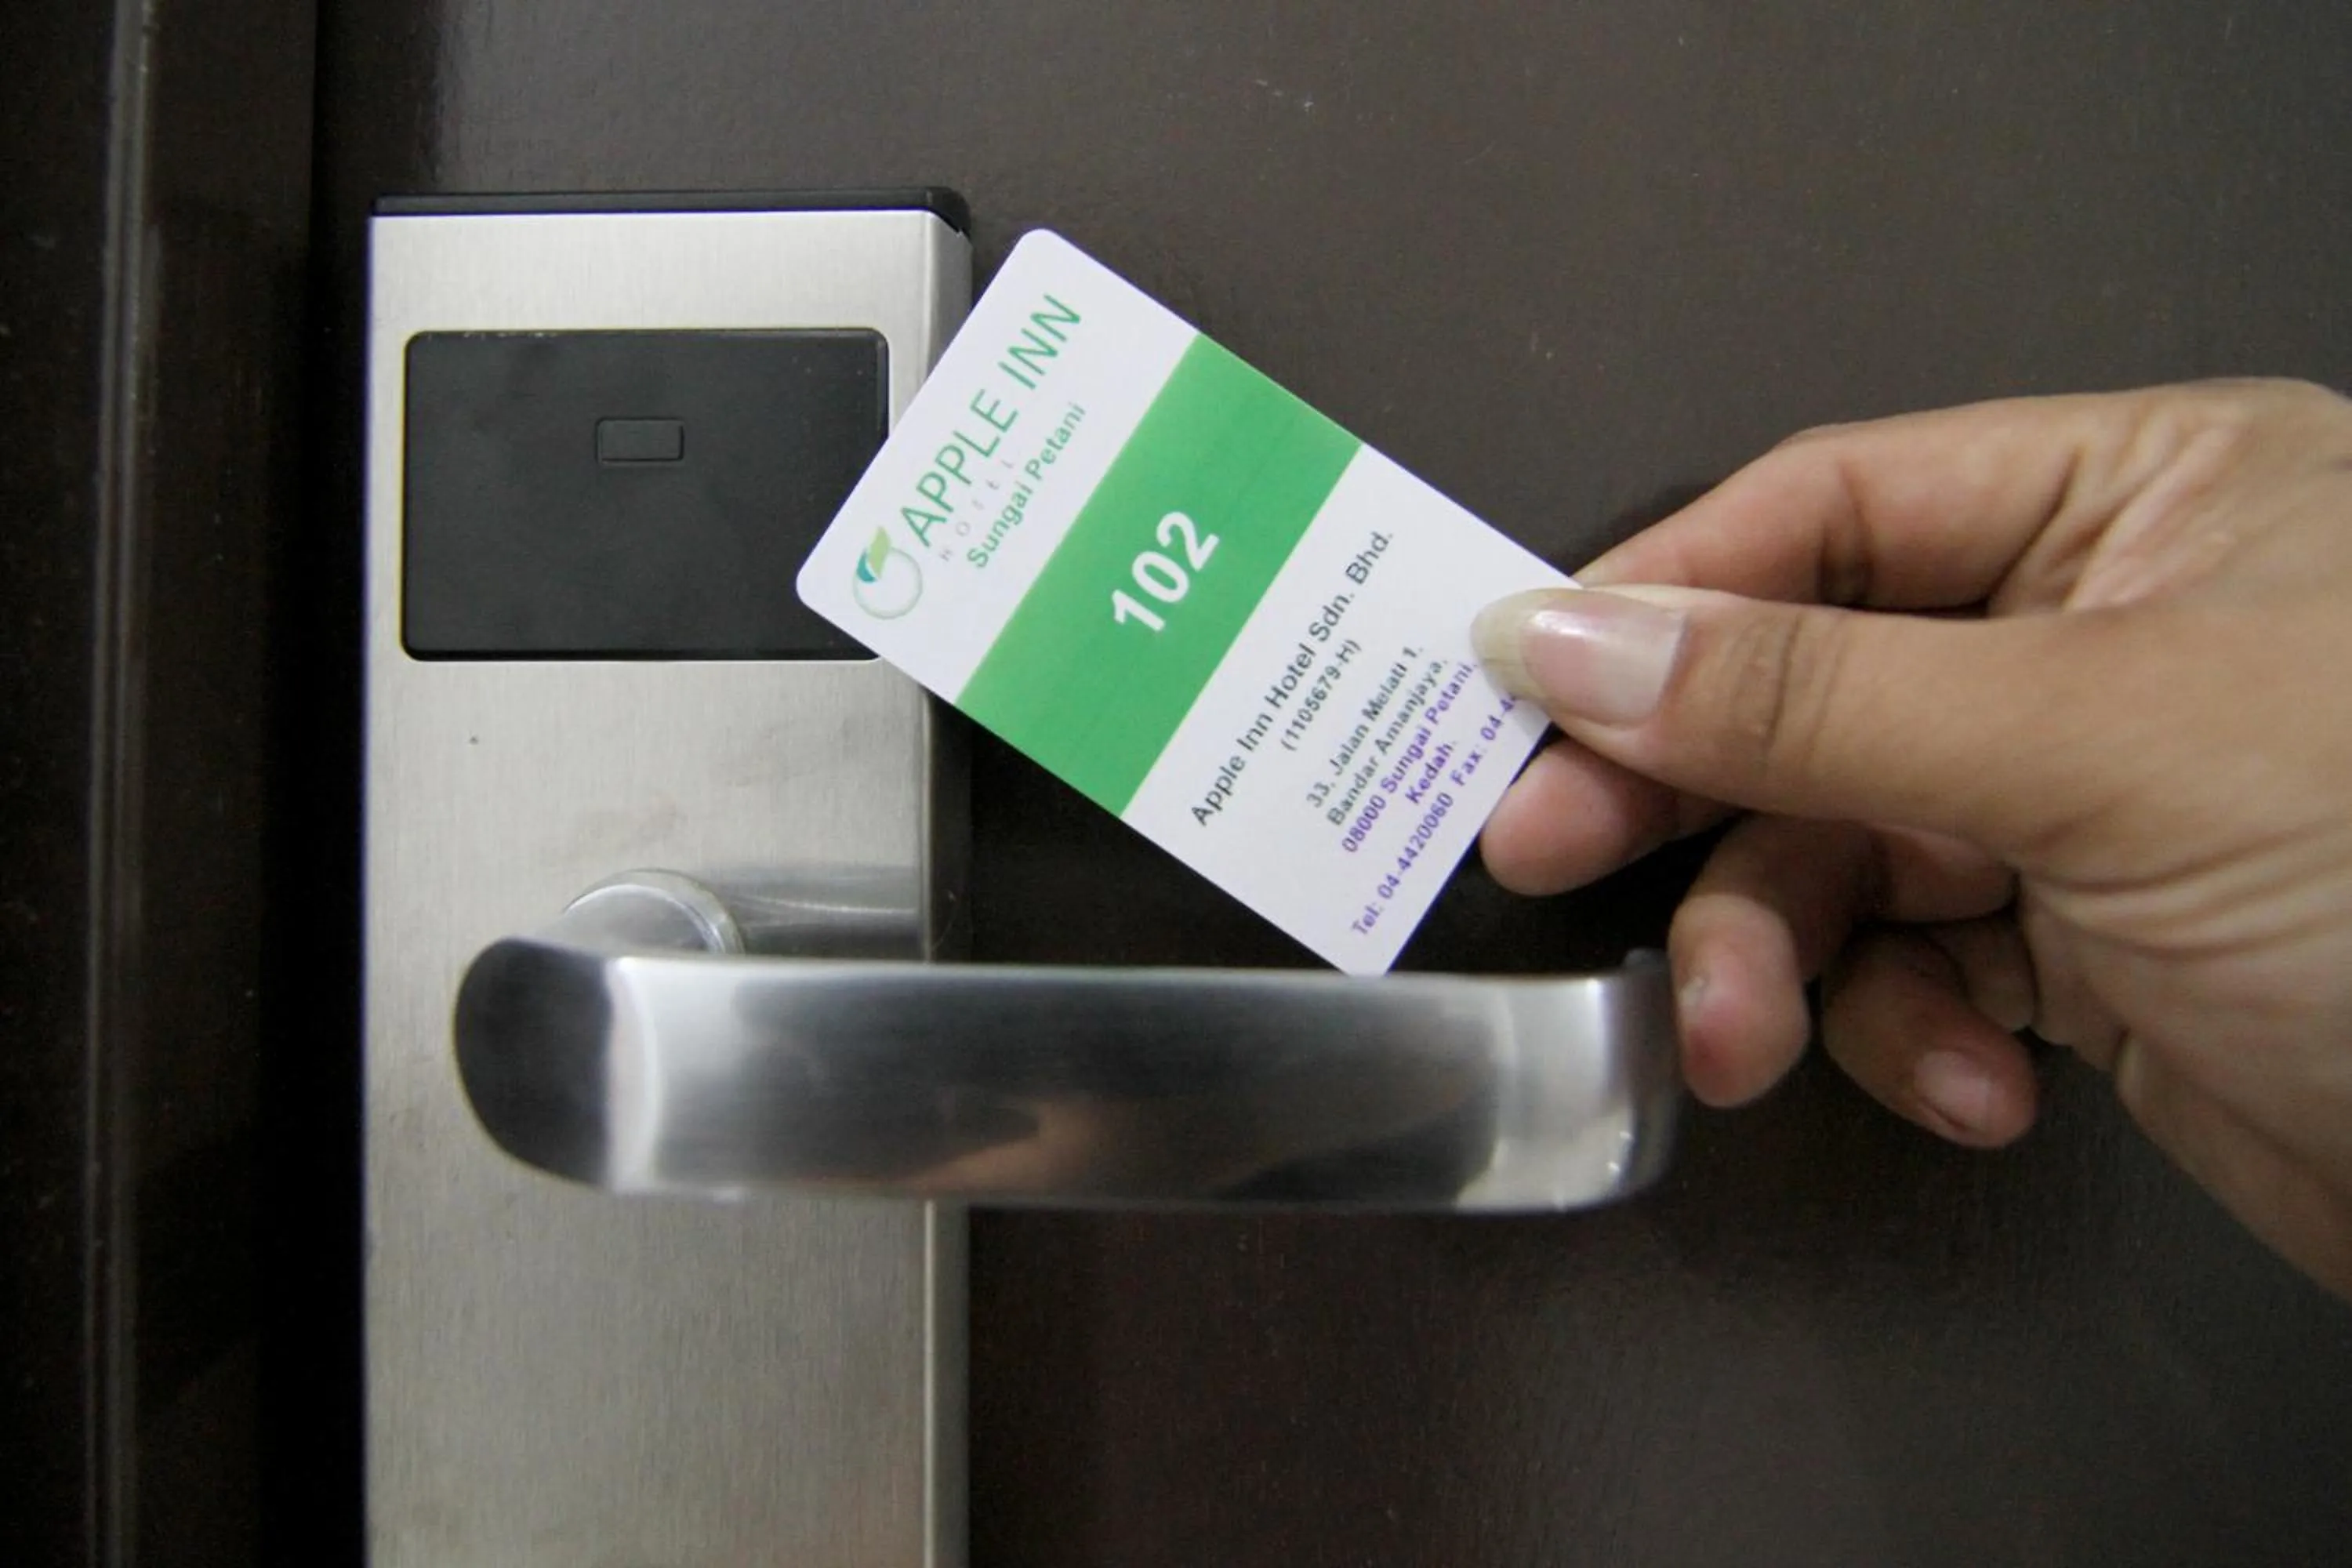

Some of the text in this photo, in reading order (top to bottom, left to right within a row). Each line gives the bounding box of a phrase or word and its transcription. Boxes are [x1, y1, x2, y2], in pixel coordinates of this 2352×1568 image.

[901, 293, 1082, 548] APPLE INN
[966, 401, 1087, 569] Sungai Petani
[1111, 511, 1221, 633] 102
[1190, 531, 1394, 828] Apple Inn Hotel Sdn. Bhd.
[1281, 638, 1362, 752] (1105679-H)
[1330, 724, 1370, 777] Jalan
[1362, 662, 1409, 723] Melati
[1327, 756, 1381, 827] Bandar
[1341, 794, 1387, 854] 08000
[1381, 726, 1432, 795] Sungai
[1405, 740, 1457, 806] Kedah.
[1352, 902, 1385, 937] Tel:
[1377, 792, 1454, 901] 04-4420060
[1450, 743, 1480, 787] Fax:
